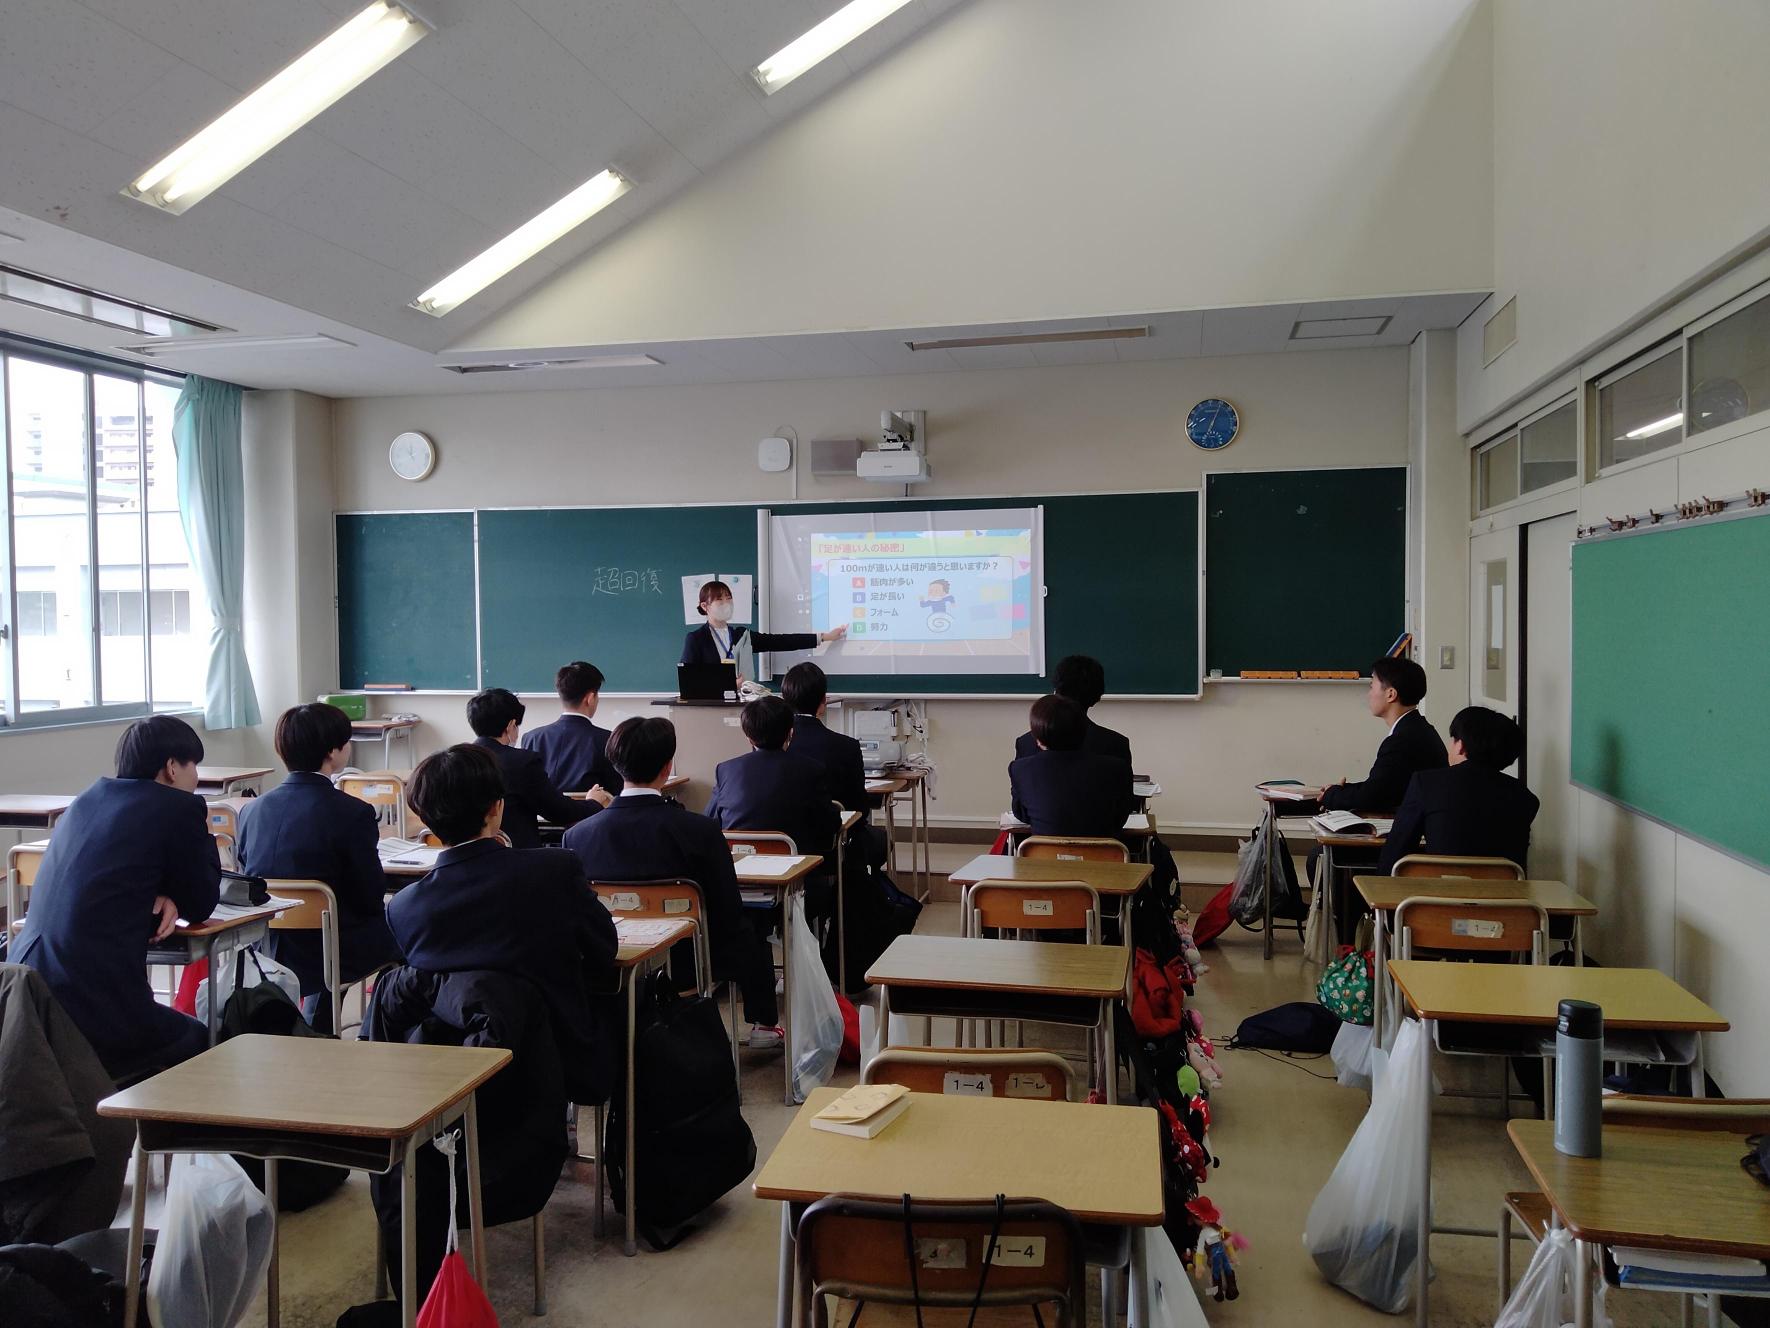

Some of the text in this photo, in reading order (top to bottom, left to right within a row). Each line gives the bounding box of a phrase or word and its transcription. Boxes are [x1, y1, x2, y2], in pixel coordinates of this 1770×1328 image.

[870, 592, 905, 601] 足が長い
[870, 608, 899, 617] フォーム
[953, 1079, 985, 1092] 1-4
[993, 1243, 1035, 1259] 1-4
